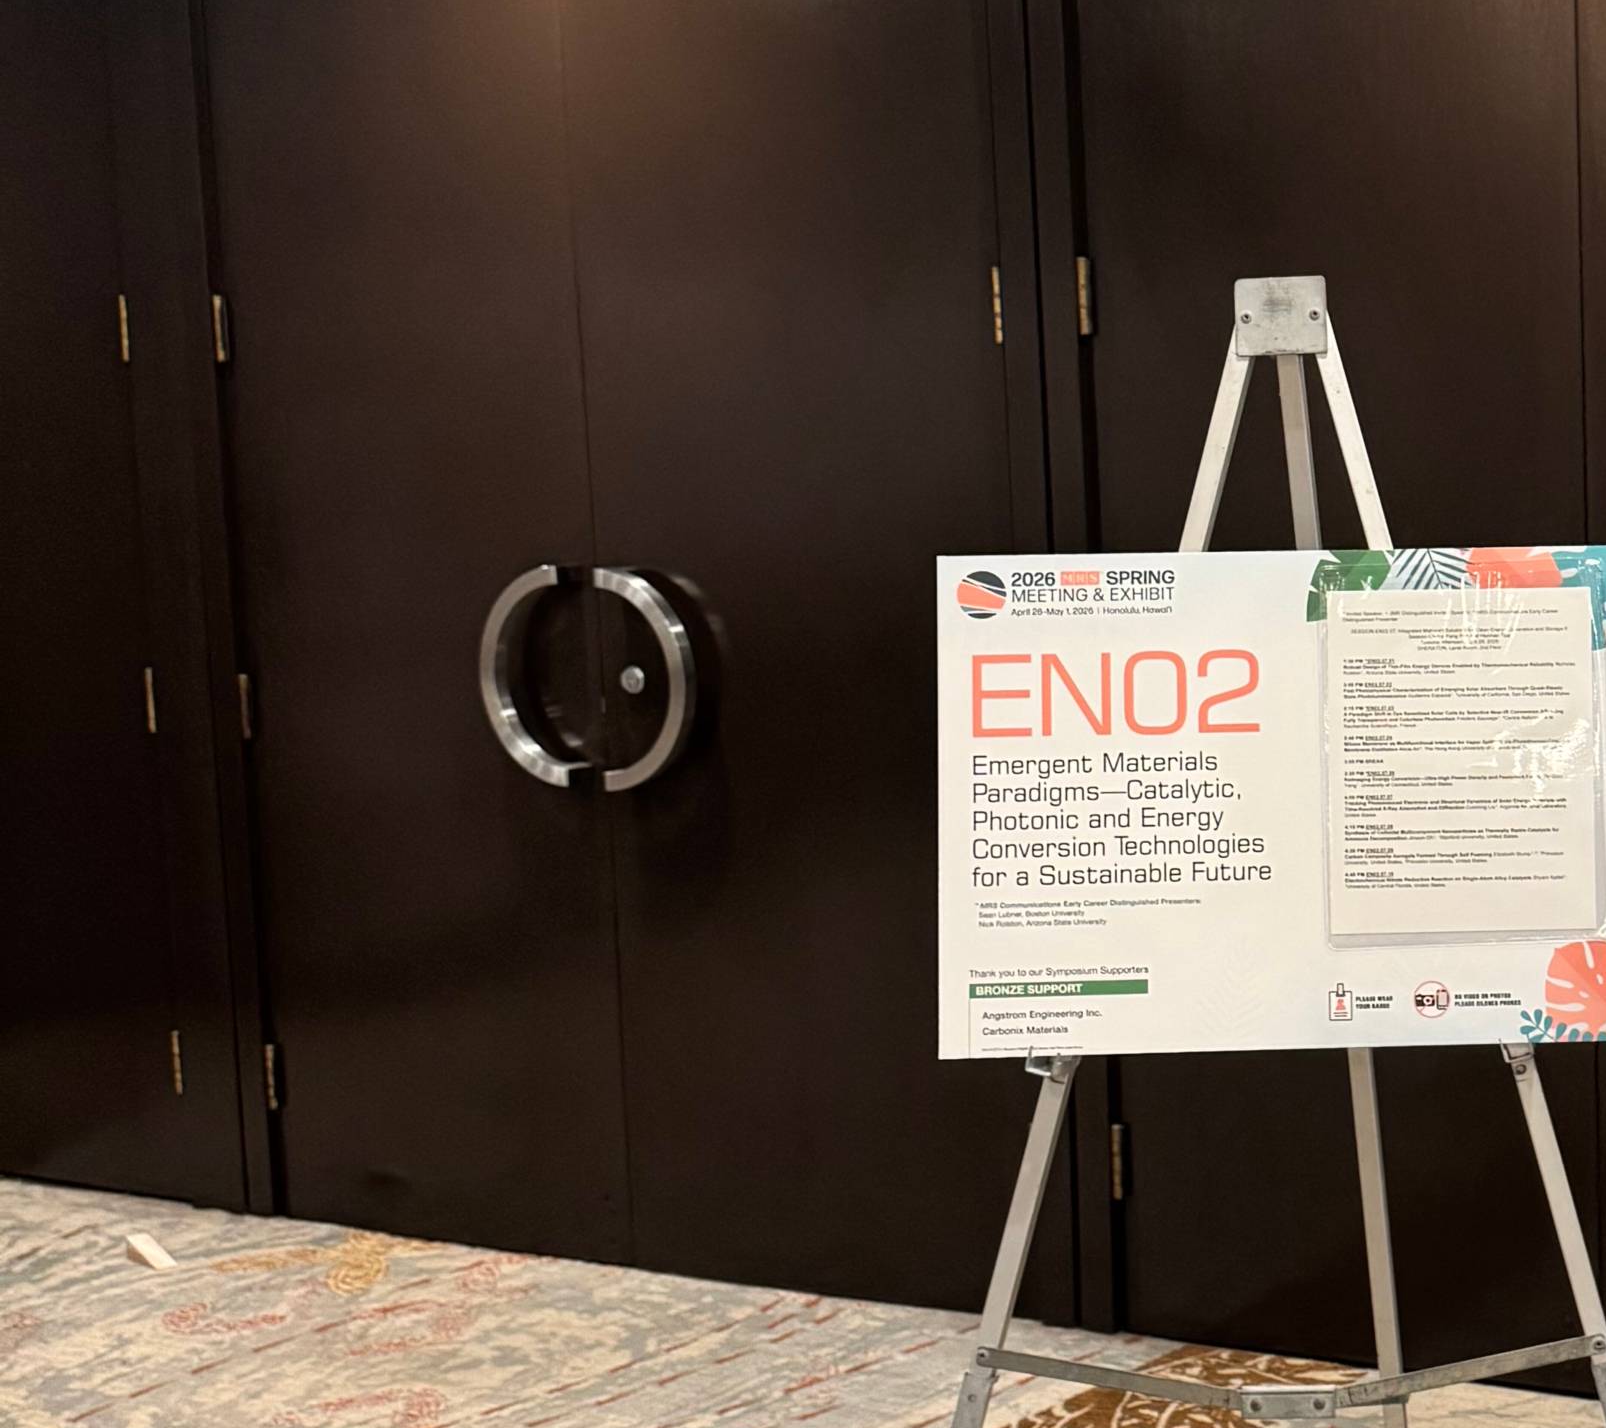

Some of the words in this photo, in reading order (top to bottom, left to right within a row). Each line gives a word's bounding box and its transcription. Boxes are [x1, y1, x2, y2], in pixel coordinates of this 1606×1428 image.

[1012, 572, 1055, 586] 2026
[1106, 570, 1175, 585] SPRING
[1012, 589, 1088, 602] MEETING
[1093, 588, 1104, 601] &
[1110, 587, 1174, 601] EXHIBIT
[973, 755, 1092, 778] Emergent
[1103, 751, 1217, 772] Materials
[973, 810, 1079, 831] Photonic
[1089, 808, 1131, 828] and
[1141, 808, 1224, 830] Energy
[973, 837, 1105, 859] Conversion
[1115, 833, 1265, 857] Technologies
[973, 867, 1007, 887] for
[1016, 871, 1029, 886] a
[1040, 863, 1182, 886] Sustainable
[1192, 862, 1272, 882] Future
[970, 969, 996, 978] Thank
[999, 970, 1015, 979] you
[1046, 967, 1097, 976] Symposium
[1100, 965, 1148, 974] Supporters
[976, 985, 1024, 996] BRONZE
[1027, 983, 1082, 994] SUPPORT
[982, 1011, 1027, 1020] Angstrom
[1029, 1010, 1083, 1019] Engineering
[982, 1027, 1023, 1035] Carbonix
[1027, 1025, 1068, 1034] Materials
